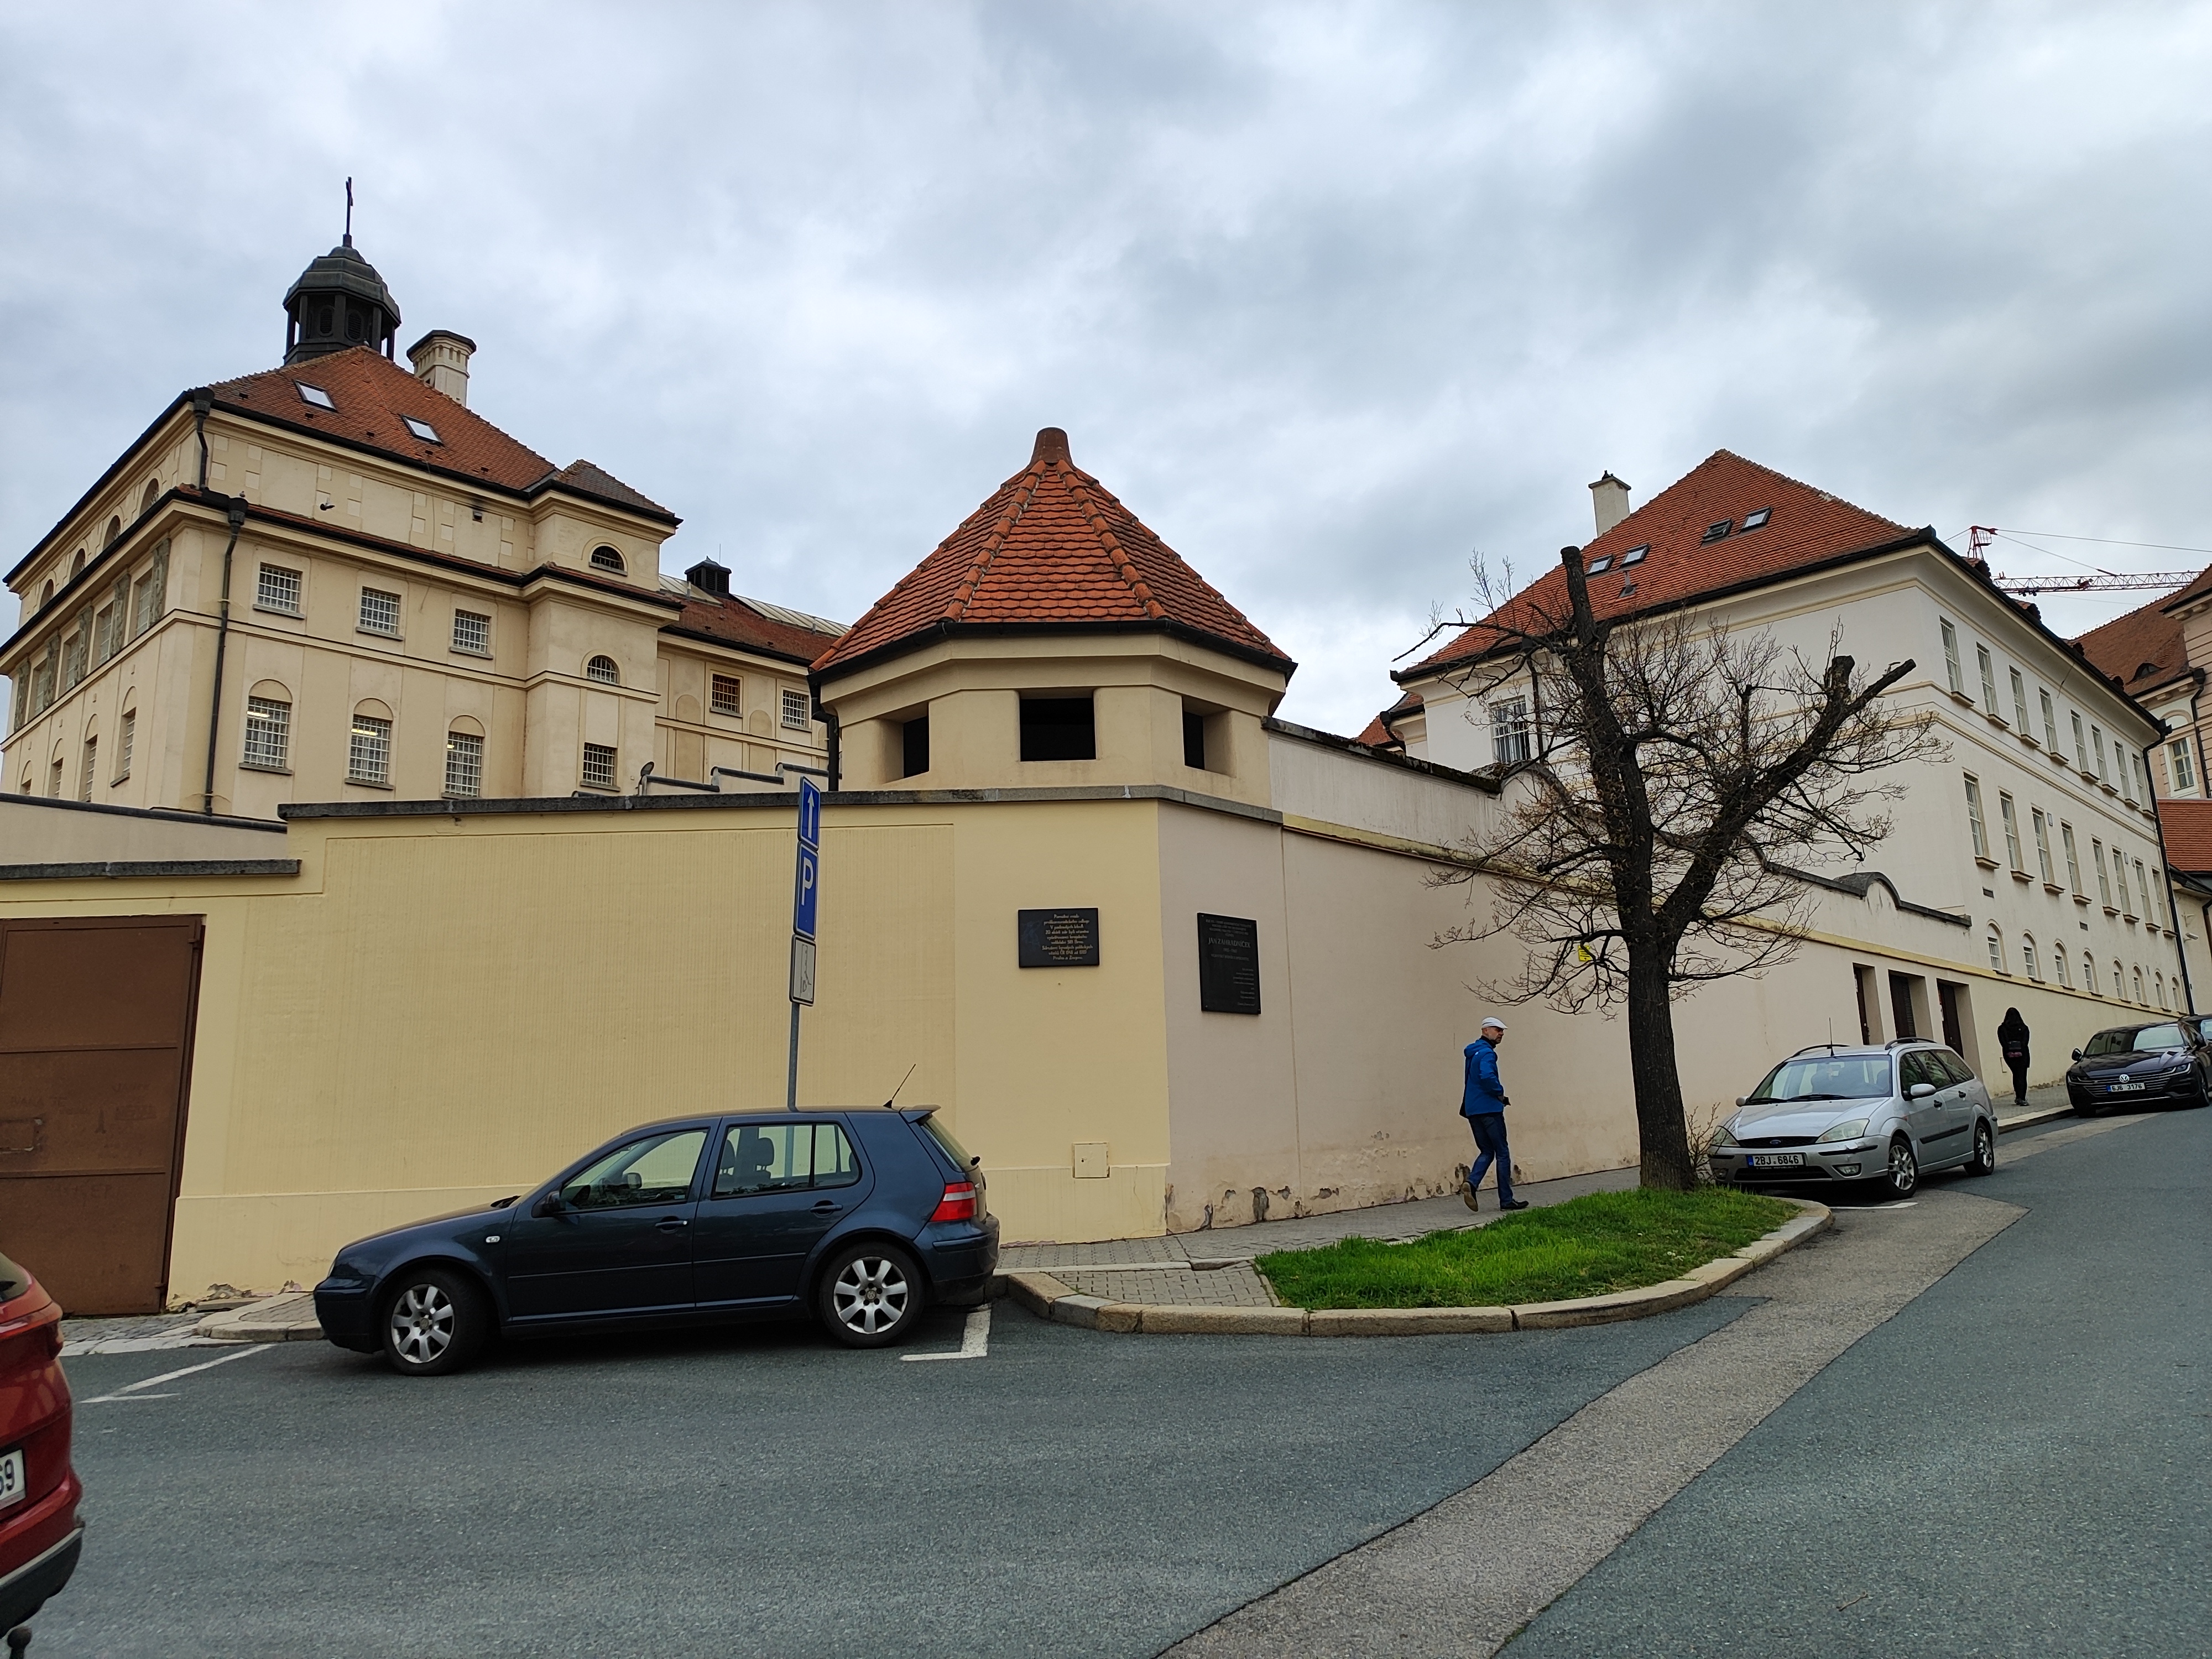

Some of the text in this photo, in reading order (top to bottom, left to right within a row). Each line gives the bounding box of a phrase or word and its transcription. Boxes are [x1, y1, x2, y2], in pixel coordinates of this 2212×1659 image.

[801, 857, 813, 906] P
[1755, 1155, 1799, 1165] 2BJ 6846
